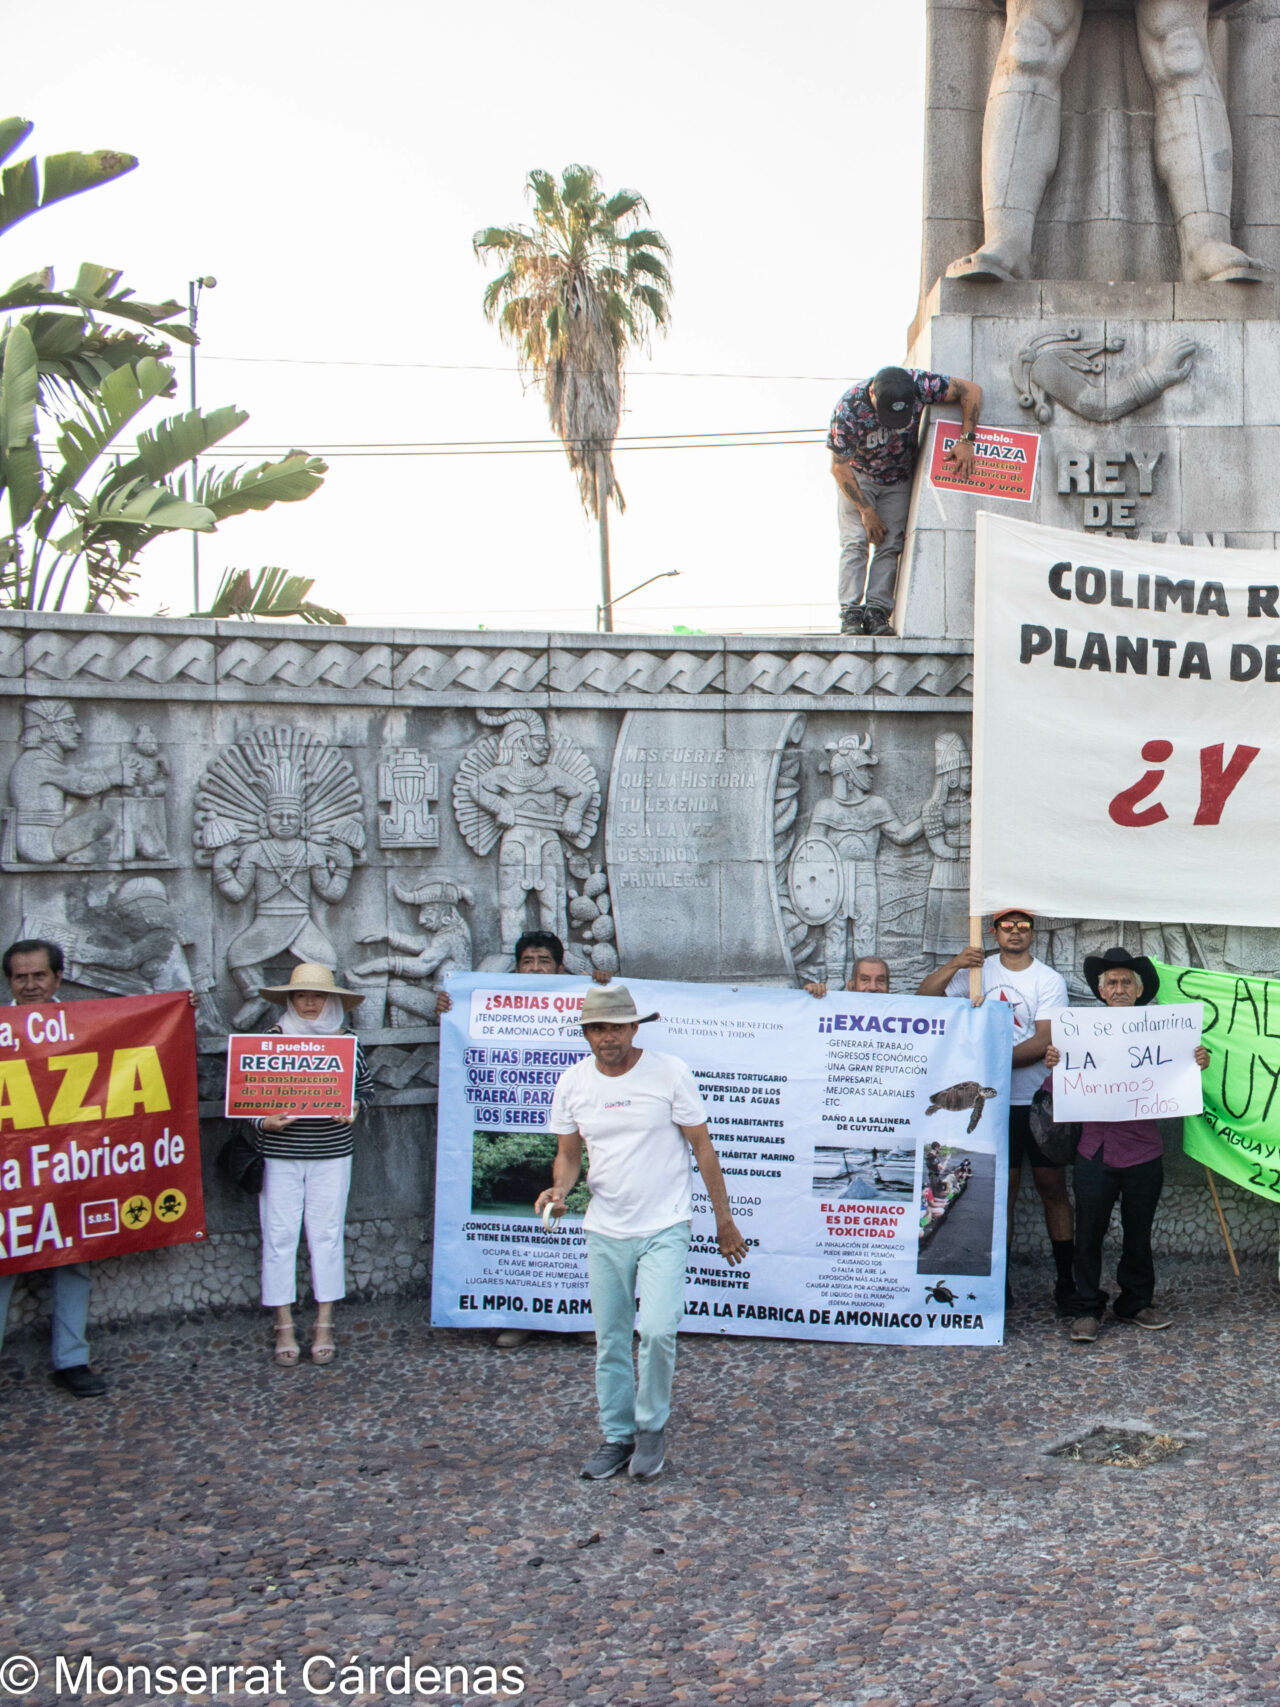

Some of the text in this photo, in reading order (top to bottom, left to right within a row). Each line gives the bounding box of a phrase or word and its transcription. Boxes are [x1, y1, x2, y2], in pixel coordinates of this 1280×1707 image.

[943, 437, 1027, 463] RHAZA
[1058, 451, 1164, 496] REY
[1084, 499, 1136, 529] DE
[1048, 561, 1230, 618] COLIMA
[1019, 623, 1212, 680] PLANTA
[1108, 739, 1261, 828] ¿Y
[485, 994, 585, 1013] ¿SABIAS QUE
[538, 1015, 558, 1024] UNA
[818, 1014, 946, 1035] ¡¡EXACTO!!
[1093, 1022, 1112, 1036] se
[1121, 1010, 1197, 1034] contamina
[27, 1010, 75, 1044] Col.
[482, 1026, 556, 1037] DE AMONIACO
[261, 1041, 326, 1053] El pueblo:
[876, 1041, 914, 1051] TRABAJO
[240, 1054, 344, 1072] RECHAZA
[491, 1050, 519, 1064] HAS
[524, 1051, 593, 1066] PREGUNT
[1065, 1045, 1173, 1070] LA SAL
[848, 1063, 928, 1075] GRAN REPUTACIÓN
[244, 1073, 338, 1084] la construcción
[468, 1069, 495, 1085] QUE
[737, 1072, 788, 1083] TORTUGARIO
[828, 1074, 883, 1084] EMPRESARIAL
[1063, 1071, 1154, 1096] Morimos
[240, 1086, 257, 1096] de
[276, 1086, 321, 1097] fábrica
[324, 1087, 341, 1097] de
[466, 1086, 517, 1103] TRAERÁ
[698, 1084, 781, 1096] DIVERSIDAD DE LOS
[867, 1088, 915, 1098] SALARIALES
[233, 1100, 346, 1110] amoniaco y urea.
[713, 1094, 725, 1102] DE
[729, 1095, 746, 1103] LAS
[750, 1096, 781, 1105] AGUAS
[1127, 1093, 1180, 1118] Todos
[476, 1108, 546, 1124] LOS SERES
[714, 1116, 785, 1128] LOS HABITANTES
[821, 1114, 847, 1123] DAÑO
[868, 1116, 911, 1125] SALINERA
[836, 1123, 895, 1133] DE CUYUTLÁN
[736, 1134, 786, 1145] NATURALES
[30, 1128, 186, 1187] Fabrica de
[721, 1149, 758, 1161] HÁBITAT
[761, 1153, 795, 1162] MARINO
[750, 1169, 782, 1178] DULCES
[820, 1203, 905, 1216] EL AMONIACO
[826, 1216, 898, 1227] ES DE GRAN
[502, 1224, 511, 1232] LA
[512, 1224, 533, 1234] GRAN
[827, 1227, 896, 1239] TOXICIDAD
[466, 1233, 476, 1241] SE
[477, 1233, 499, 1242] TIENE
[500, 1234, 511, 1242] EN
[512, 1235, 531, 1244] ESTA
[560, 1237, 571, 1246] DE
[482, 1248, 510, 1257] OCUPA
[533, 1250, 560, 1260] LUGAR
[562, 1252, 581, 1260] DEL
[498, 1258, 527, 1267] EN AVE
[483, 1268, 544, 1278] EL LUGAR DE
[700, 1268, 751, 1280] NUESTRO
[465, 1277, 552, 1288] LUGARES NATURALES
[694, 1277, 750, 1290] AMBIENTE
[459, 1294, 479, 1310] EL
[482, 1295, 529, 1313] MPIO.
[532, 1297, 554, 1314] DE
[713, 1302, 732, 1318] LA
[737, 1303, 806, 1324] FABRICA
[809, 1309, 831, 1325] DE
[833, 1310, 921, 1329] AMONIACO
[926, 1313, 937, 1329] Y
[940, 1314, 984, 1330] UREA
